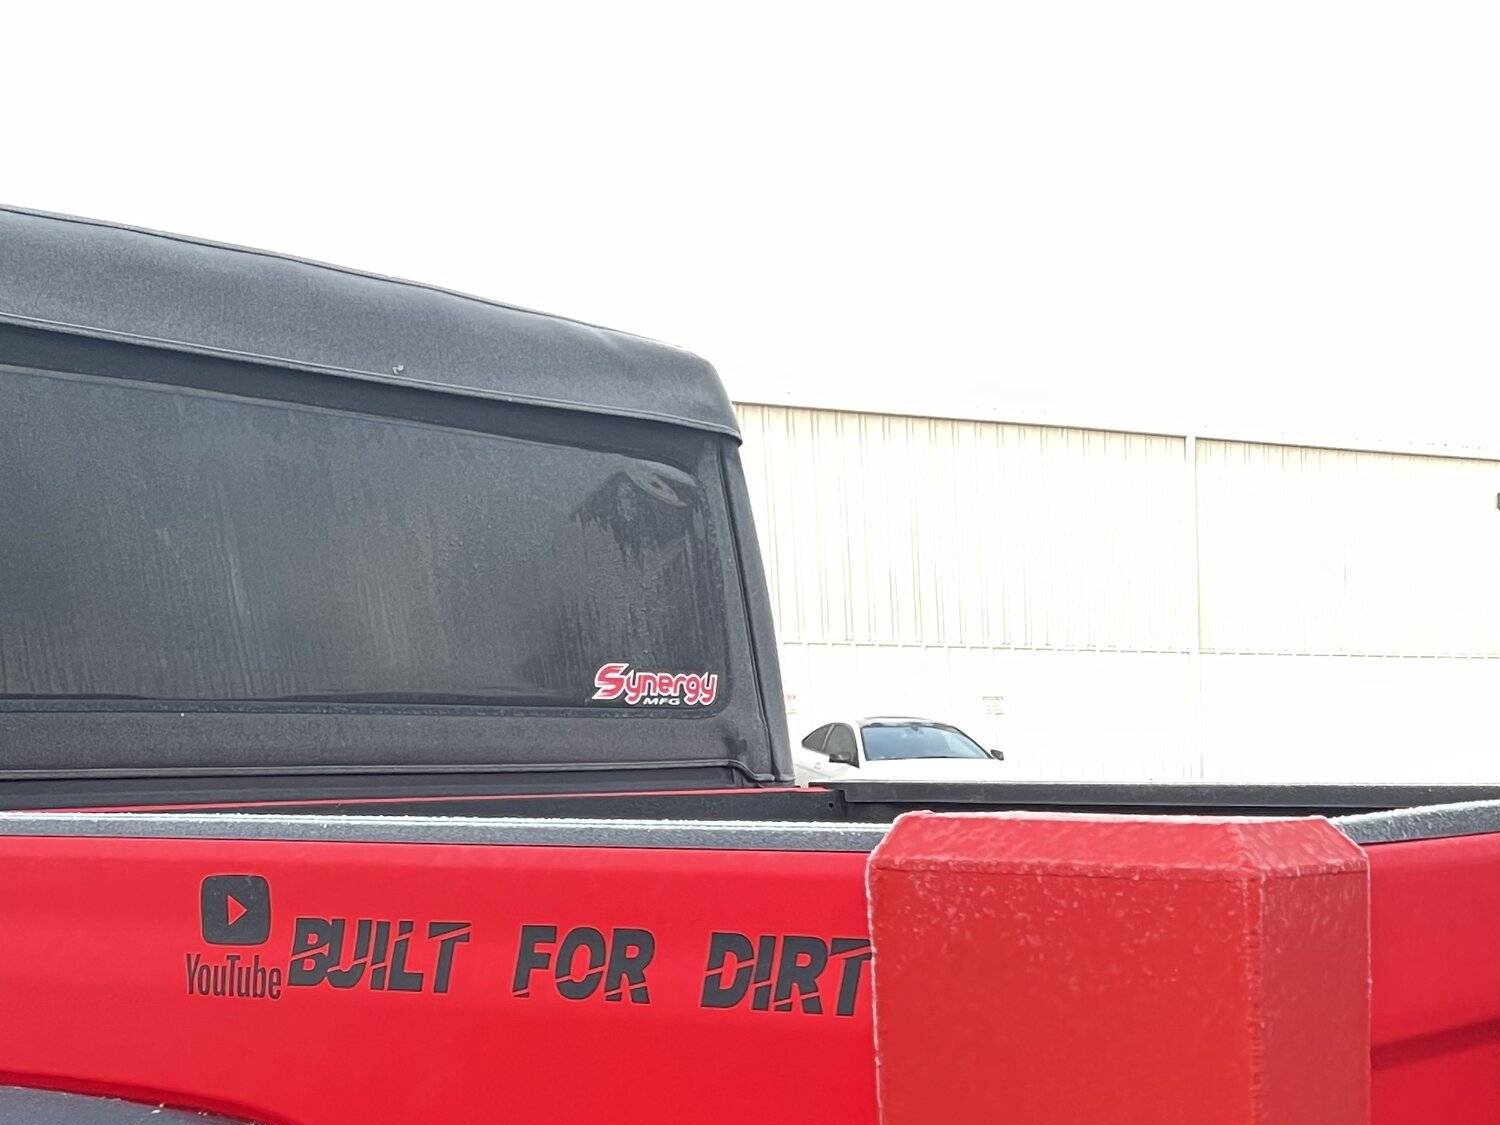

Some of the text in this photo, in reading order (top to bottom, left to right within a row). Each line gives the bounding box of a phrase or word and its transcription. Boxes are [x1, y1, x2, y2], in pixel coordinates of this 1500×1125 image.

[592, 663, 718, 706] Synergy
[643, 697, 680, 706] MFG
[186, 953, 282, 1000] YouTube
[287, 917, 873, 1017] BUILT FOR DIRT
